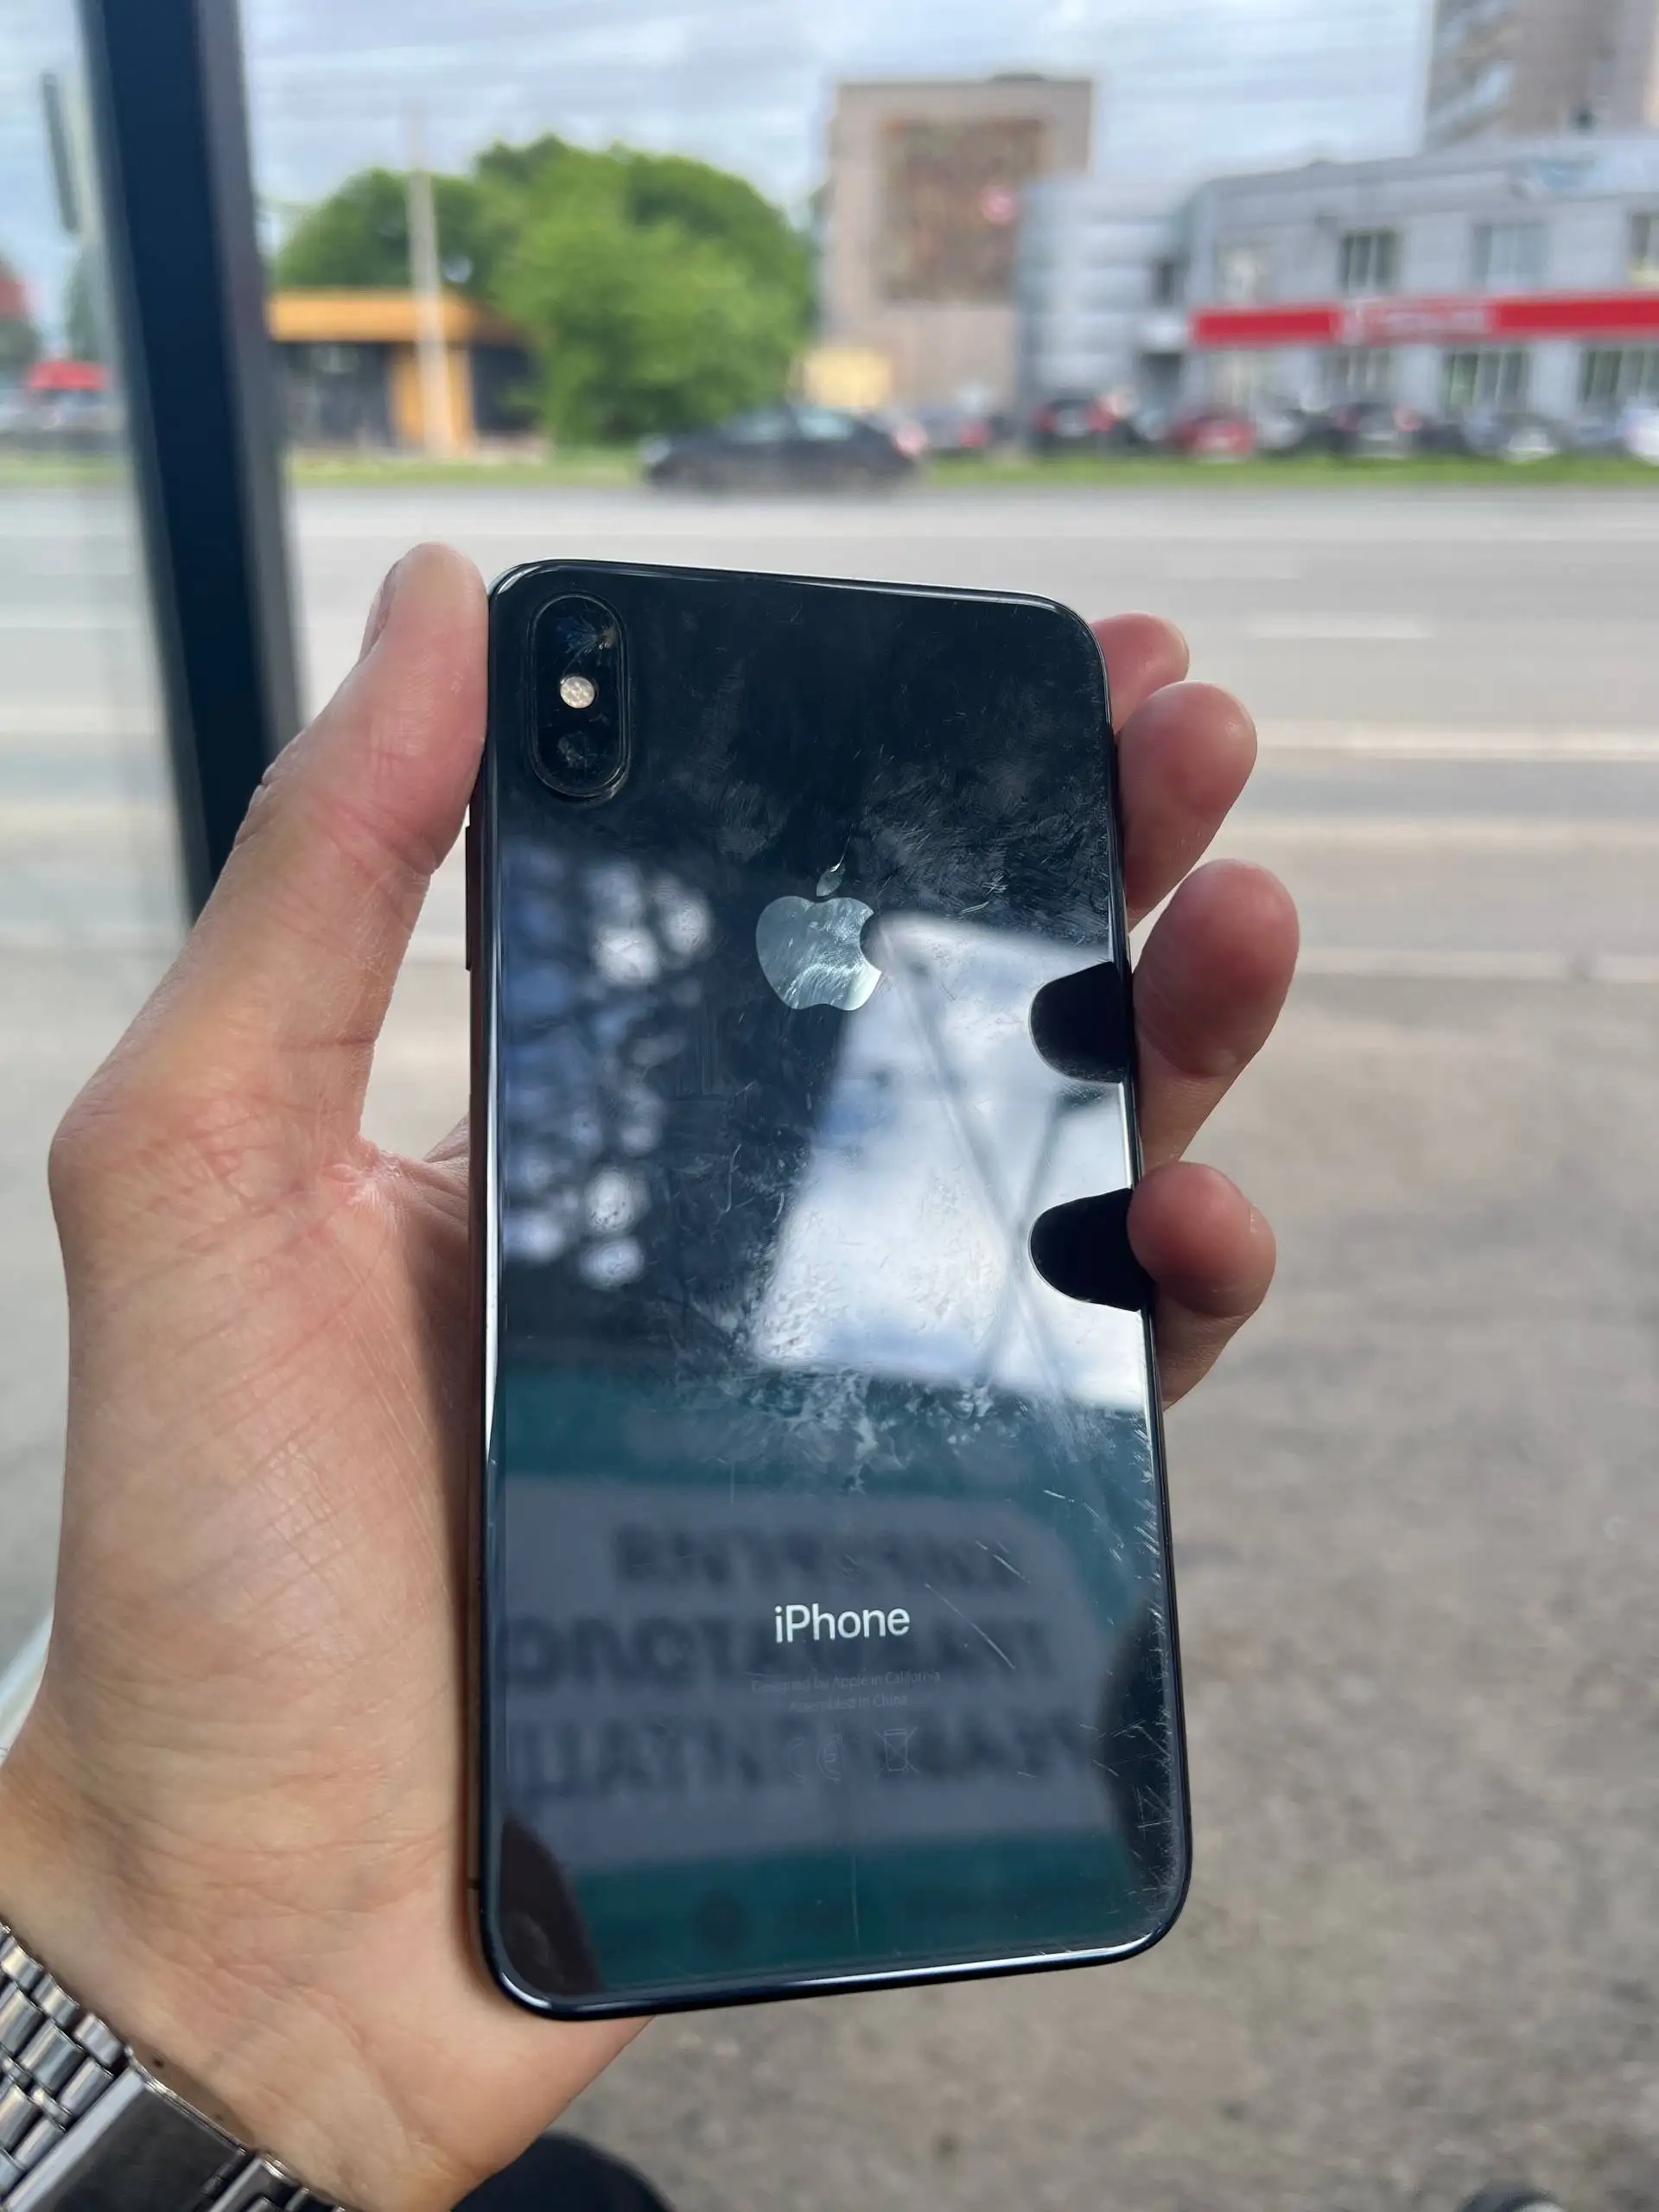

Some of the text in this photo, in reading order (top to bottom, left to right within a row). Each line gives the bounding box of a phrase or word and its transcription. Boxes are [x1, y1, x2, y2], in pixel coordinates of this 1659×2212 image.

[774, 1603, 910, 1643] iPhone
[832, 1674, 868, 1690] Apple
[871, 1673, 882, 1687] in
[885, 1669, 941, 1686] California
[859, 1695, 870, 1709] in
[873, 1693, 909, 1708] China
